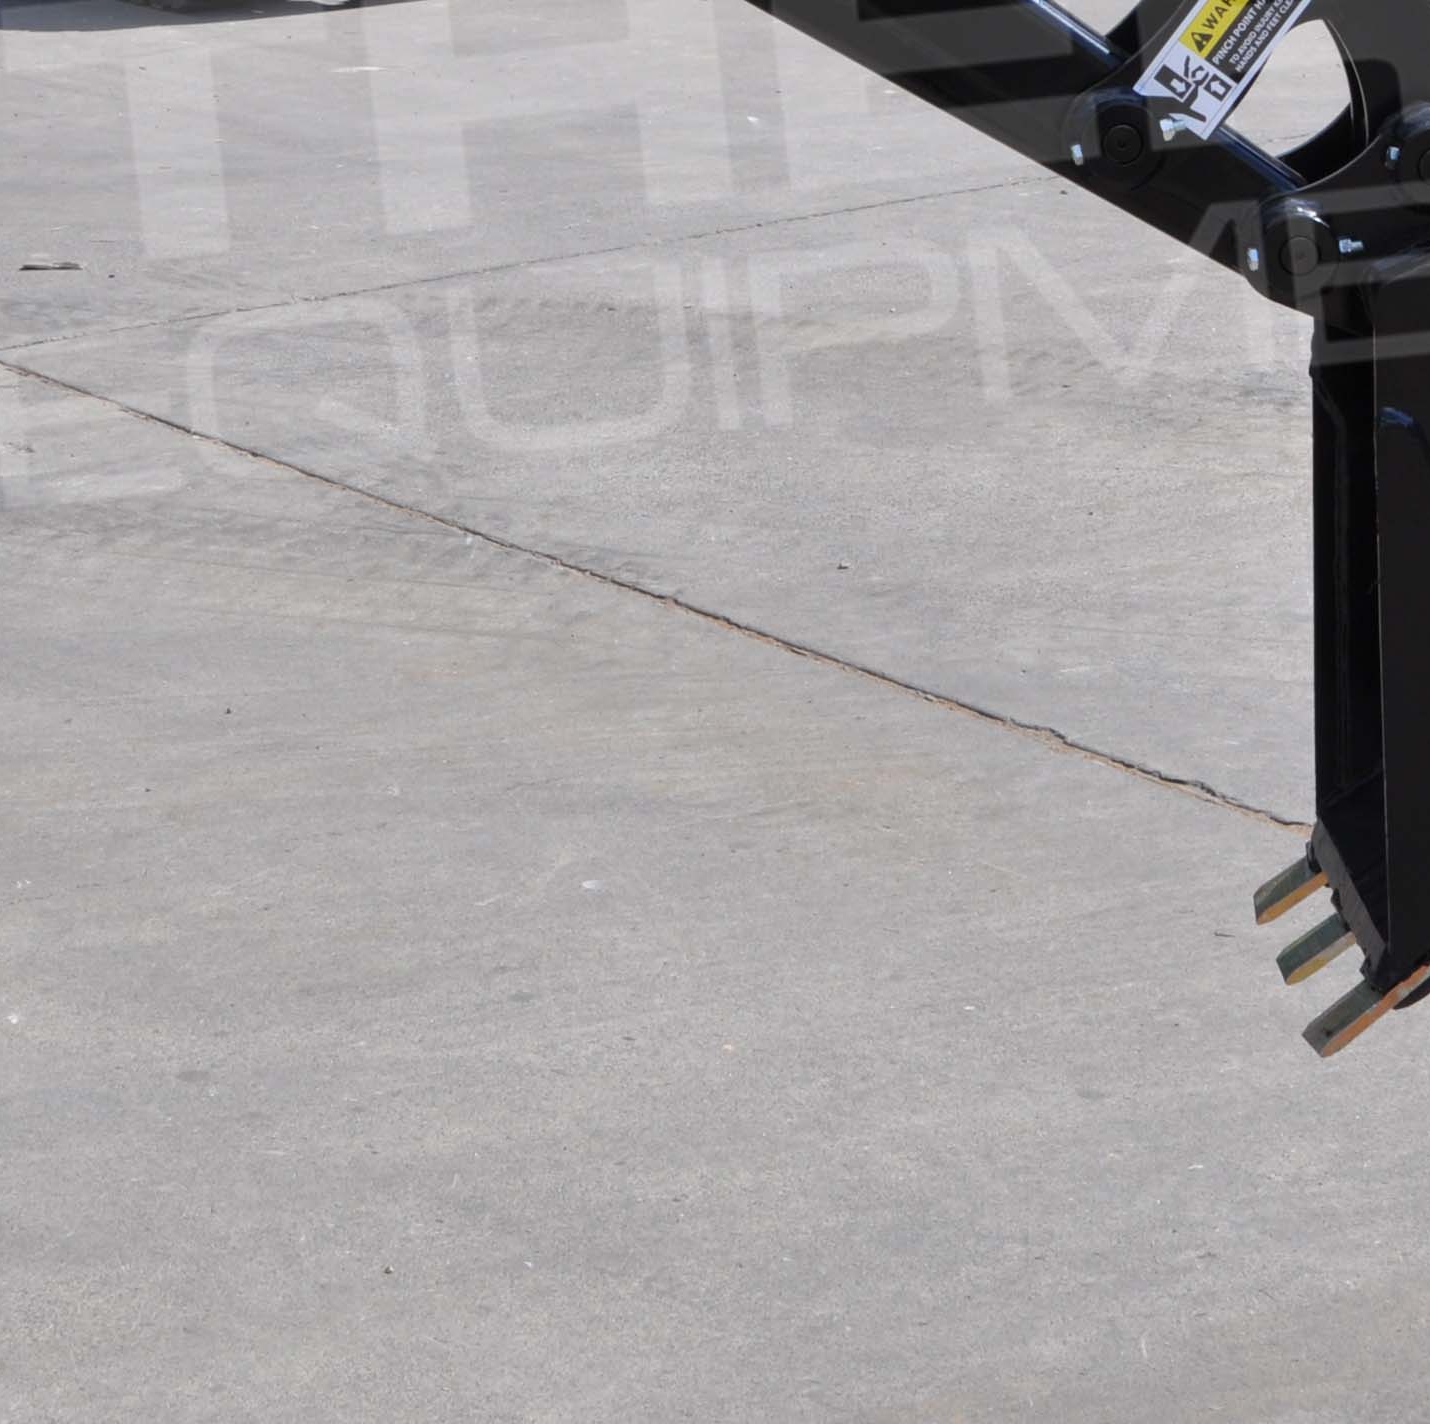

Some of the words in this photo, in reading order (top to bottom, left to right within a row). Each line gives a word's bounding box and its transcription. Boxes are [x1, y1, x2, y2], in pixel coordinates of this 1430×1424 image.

[1212, 35, 1238, 65] PINCH
[1233, 7, 1257, 37] POINT
[1229, 54, 1240, 65] TO
[1238, 31, 1256, 55] AVOID
[1253, 6, 1275, 33] INJURY
[1235, 46, 1257, 73] HANDS
[1254, 29, 1269, 49] AND
[1266, 13, 1282, 32] FEET
